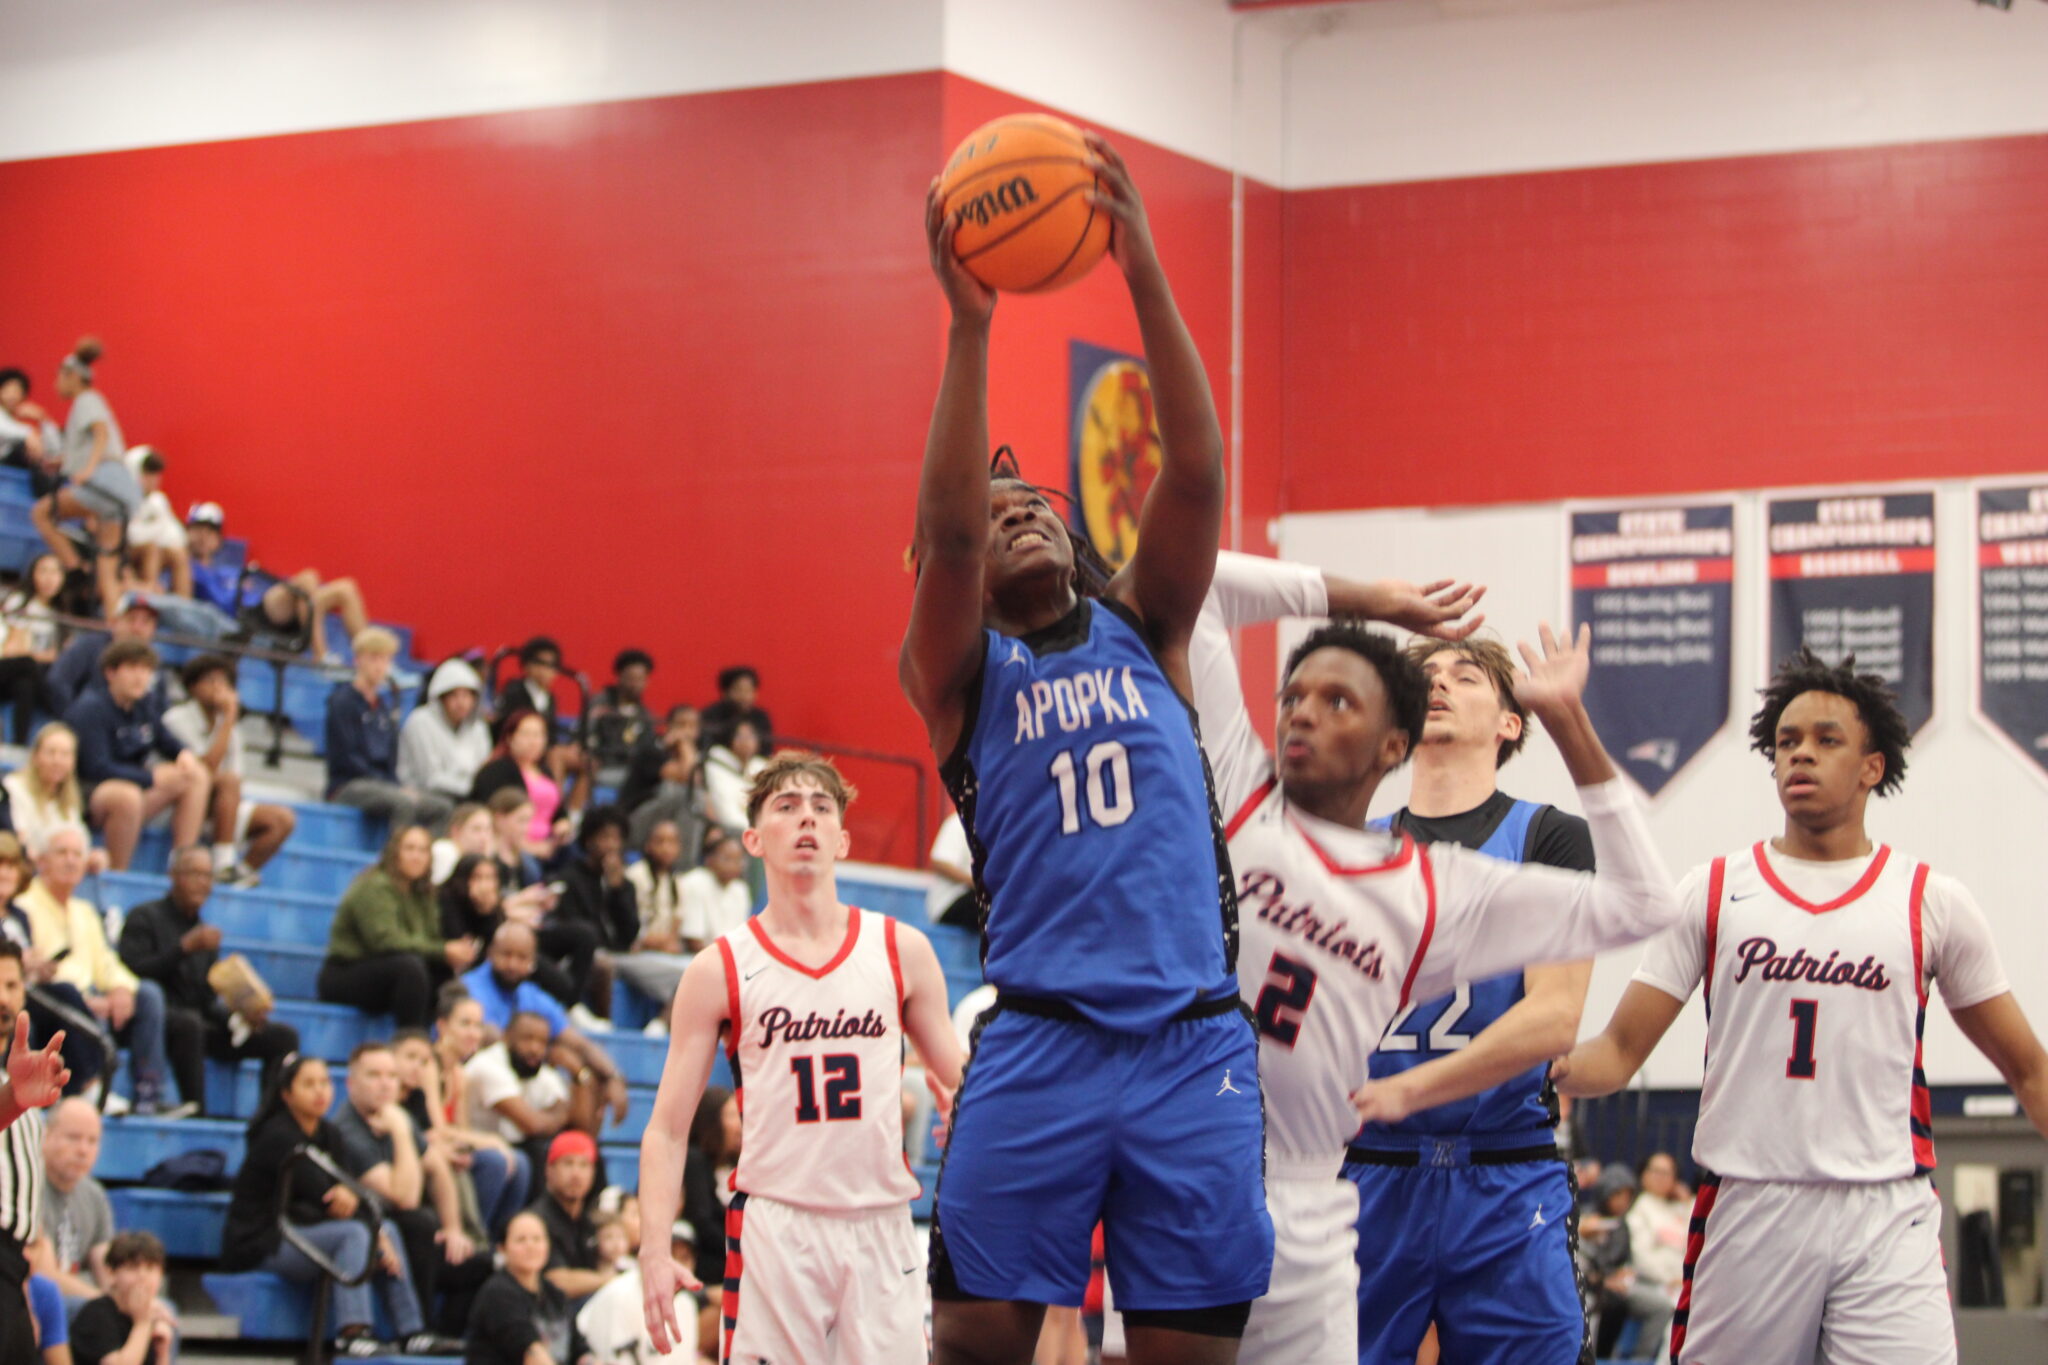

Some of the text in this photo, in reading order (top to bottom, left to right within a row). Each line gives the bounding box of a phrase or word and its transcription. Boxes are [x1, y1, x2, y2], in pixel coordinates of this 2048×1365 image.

[1014, 665, 1149, 745] APOPKA
[1049, 739, 1136, 836] 10
[1237, 869, 1385, 984] Patriots
[1734, 936, 1891, 991] Patriots
[758, 1006, 887, 1049] Patriots
[1253, 947, 1319, 1053] 2
[1786, 998, 1819, 1080] 1
[789, 1053, 863, 1125] 12
